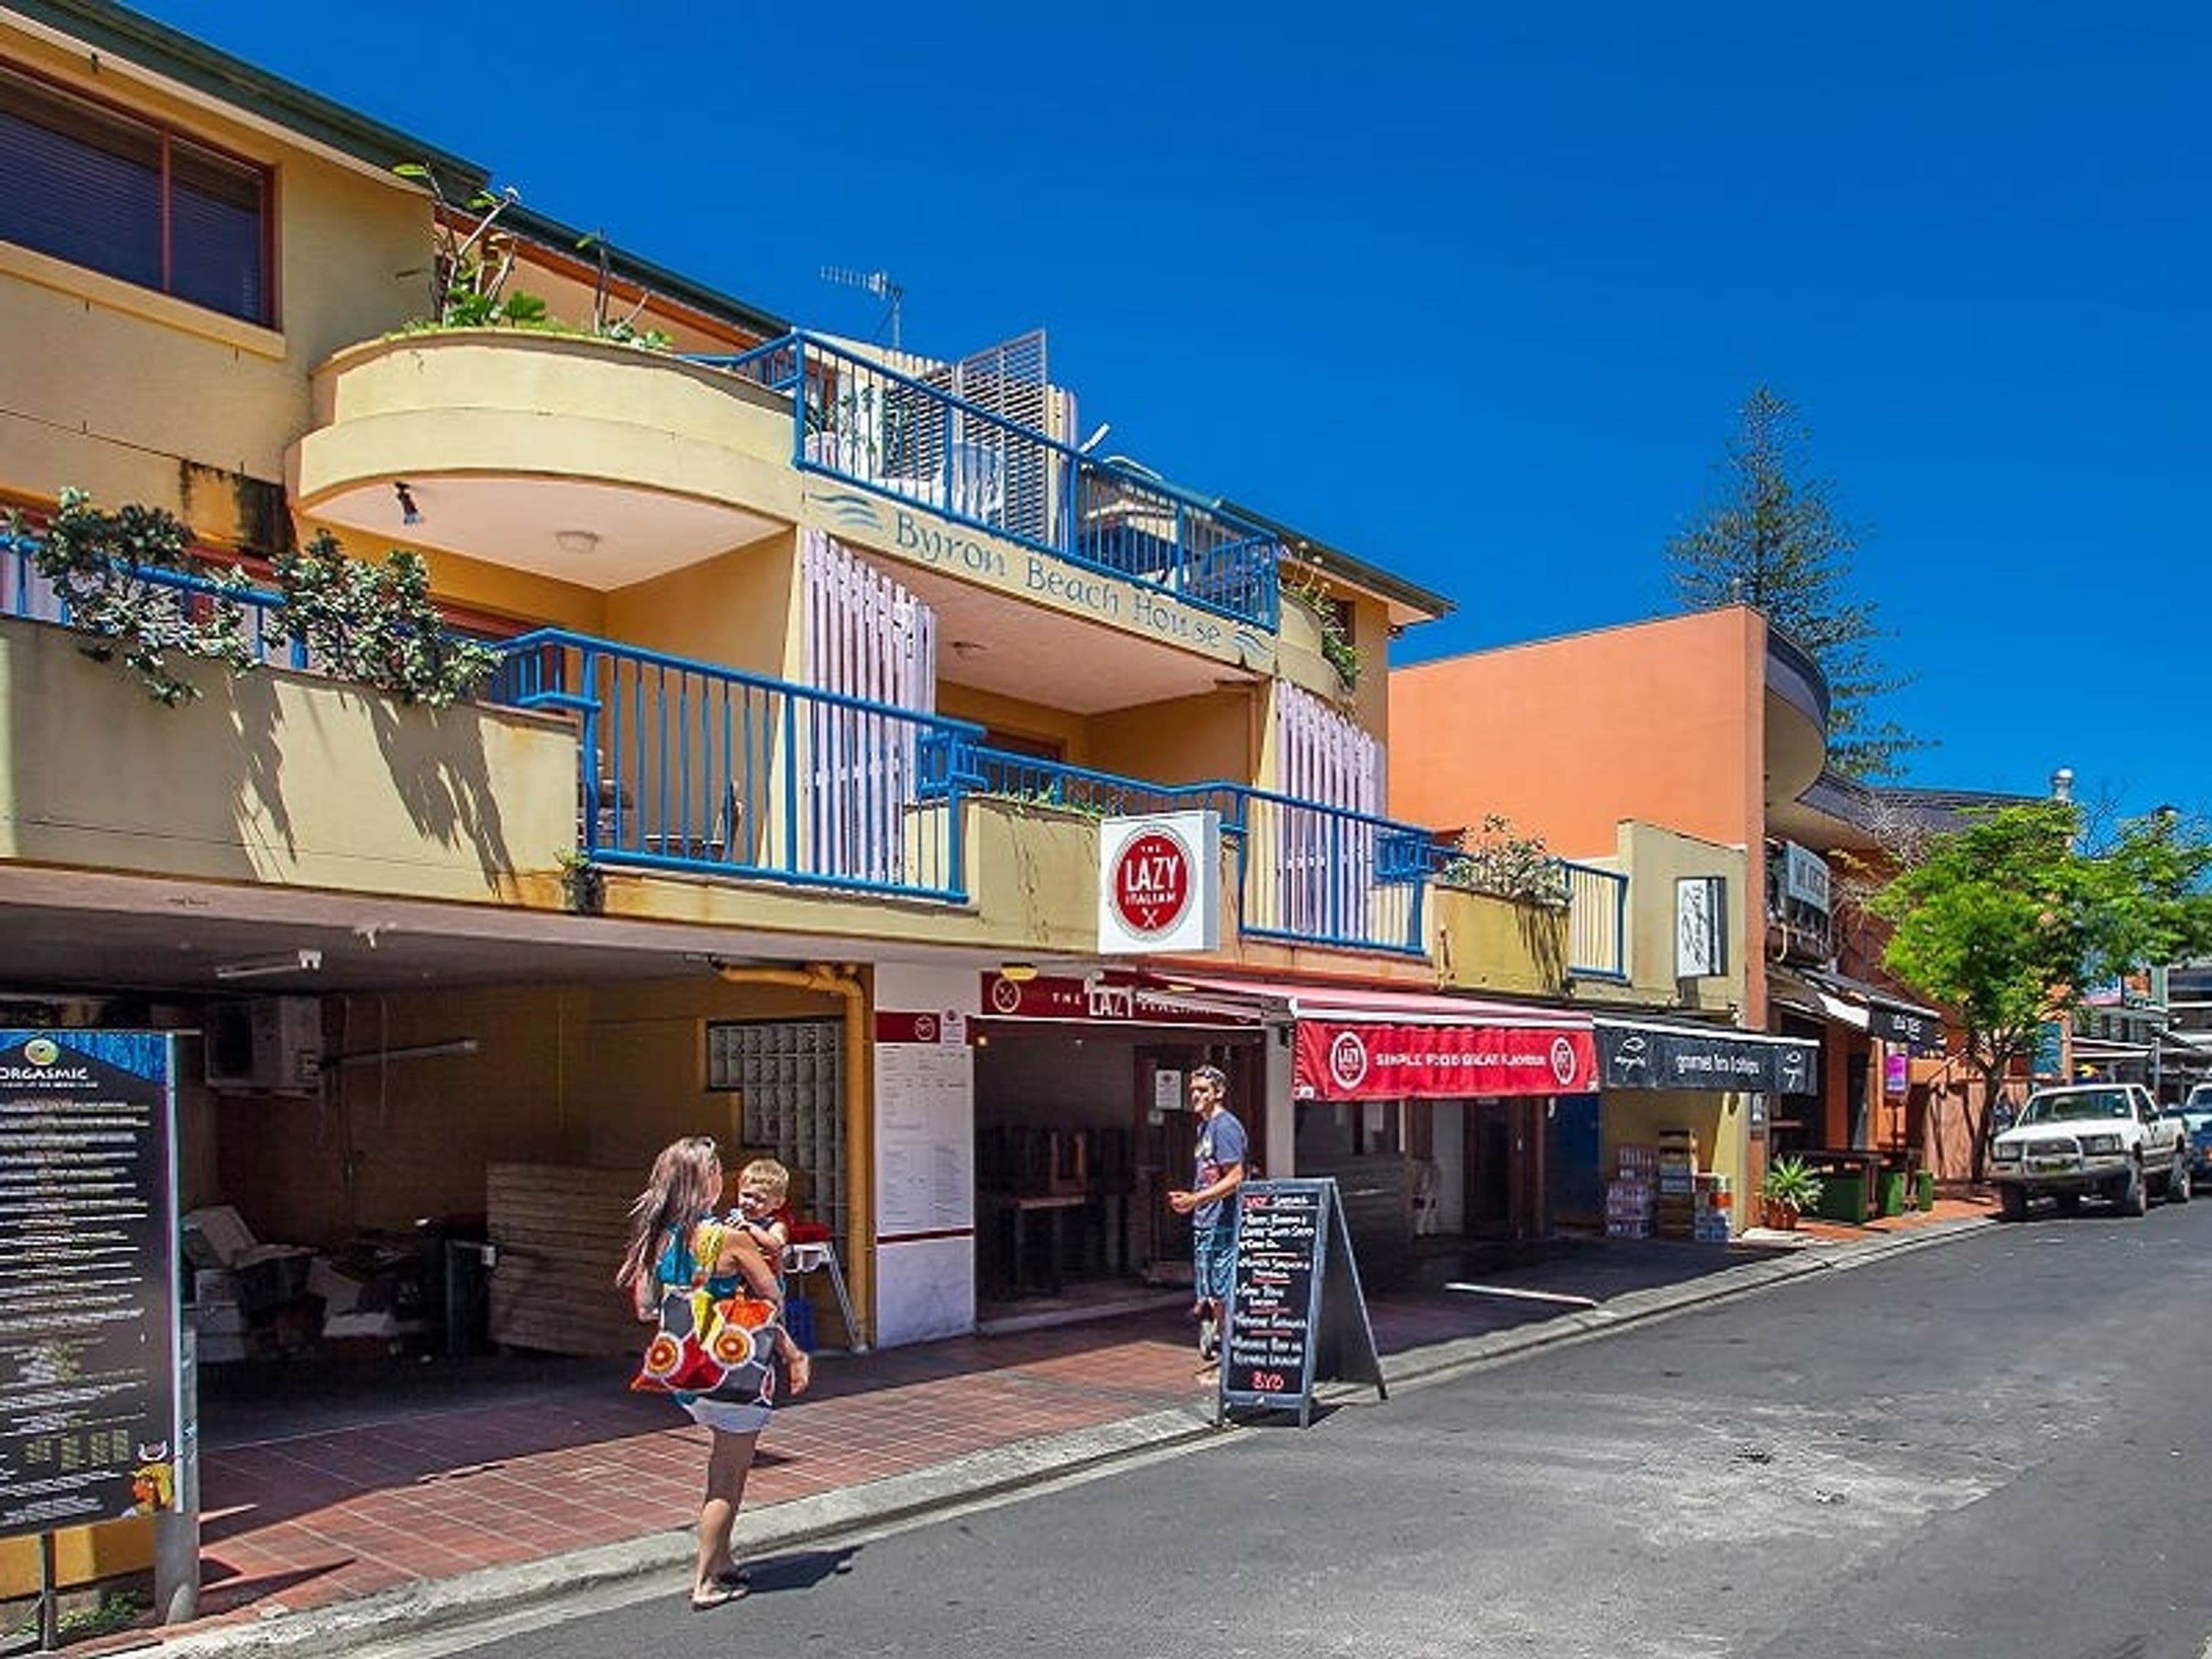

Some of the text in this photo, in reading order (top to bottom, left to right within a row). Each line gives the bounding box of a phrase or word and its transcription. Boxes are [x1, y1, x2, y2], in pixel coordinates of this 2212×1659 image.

[896, 512, 1220, 647] Byron Beach House
[1125, 854, 1179, 892] LAZY
[1053, 992, 1082, 1005] THE
[1089, 986, 1133, 1018] LAZY
[0, 1067, 88, 1080] ORGASMIC
